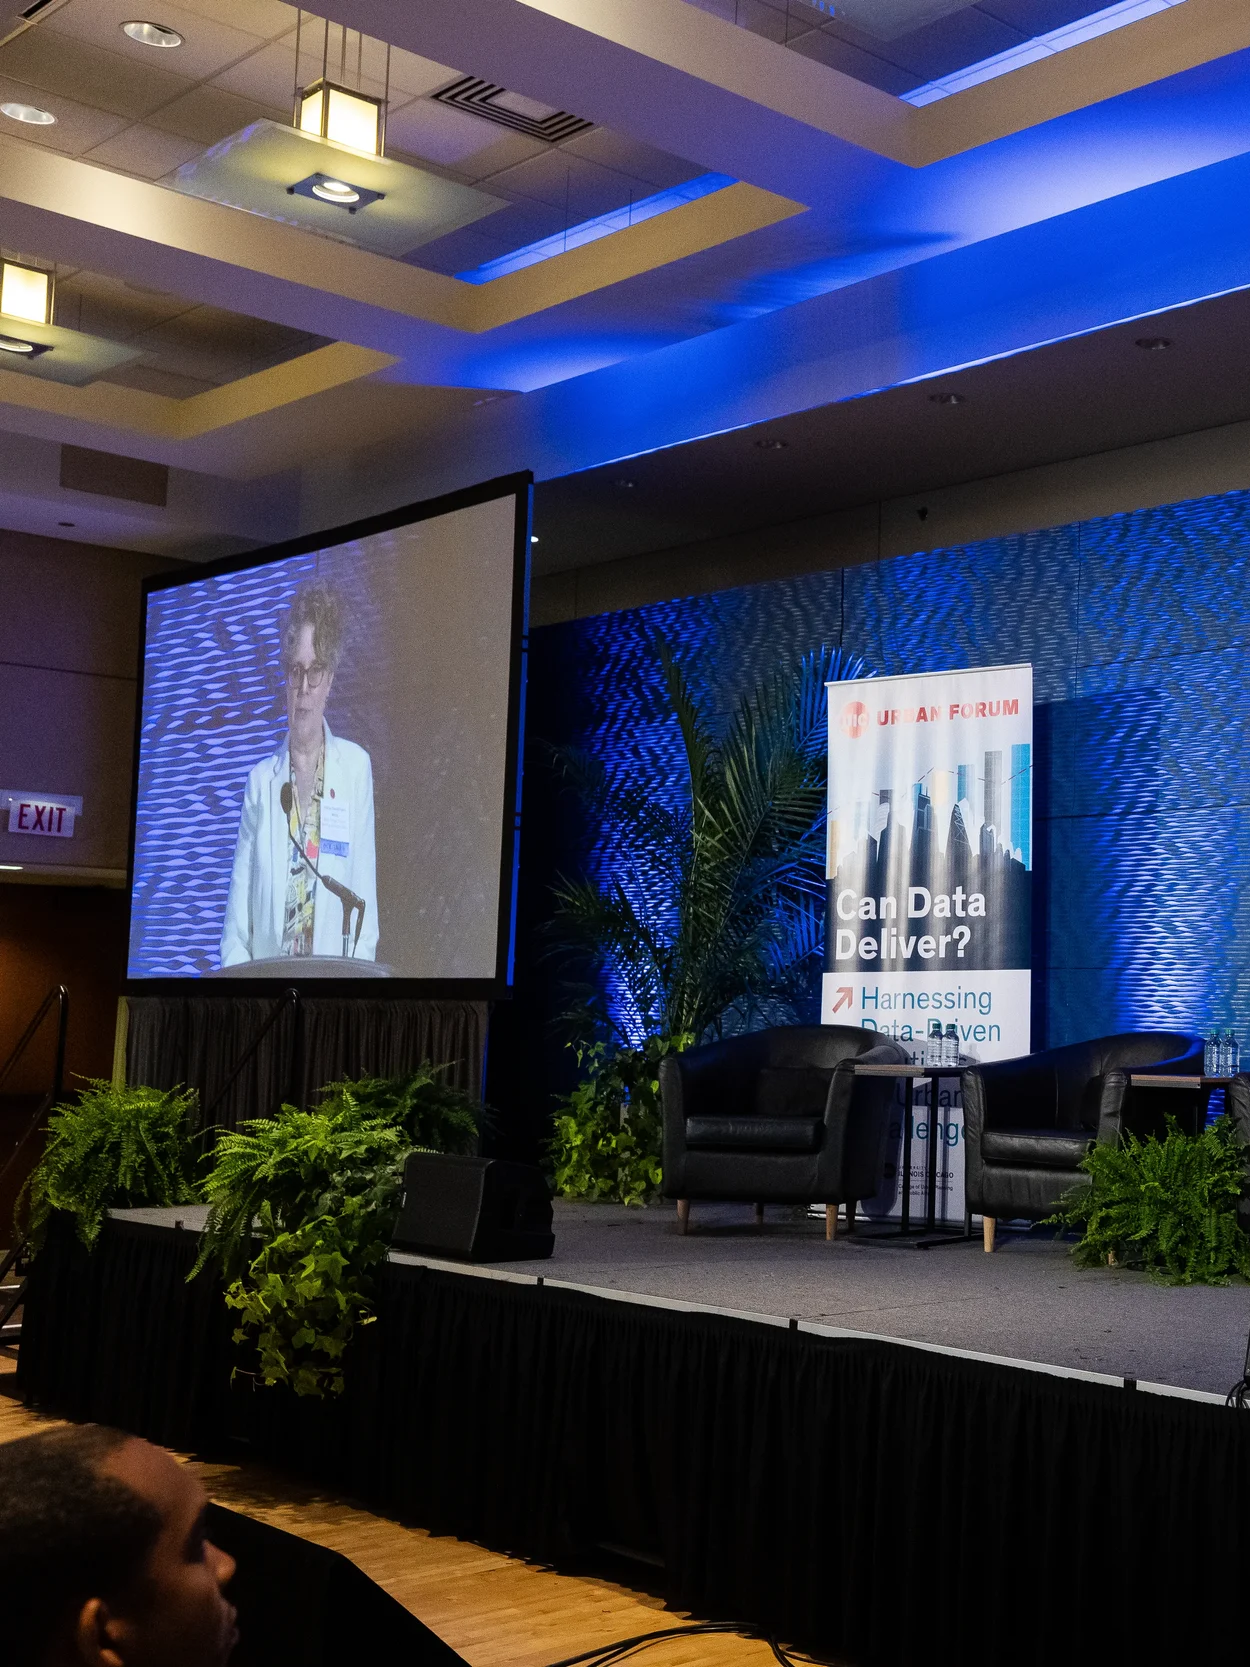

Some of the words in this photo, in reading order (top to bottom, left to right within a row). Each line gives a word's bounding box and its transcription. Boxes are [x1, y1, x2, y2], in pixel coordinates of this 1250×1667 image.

[877, 706, 941, 726] URBAN
[950, 699, 1019, 720] FORUM
[18, 804, 67, 833] EXIT
[836, 888, 897, 921] Can
[907, 885, 986, 920] Data
[835, 925, 971, 960] Deliver?
[861, 985, 992, 1015] Harnessing
[861, 1018, 1001, 1042] Data-Diven
